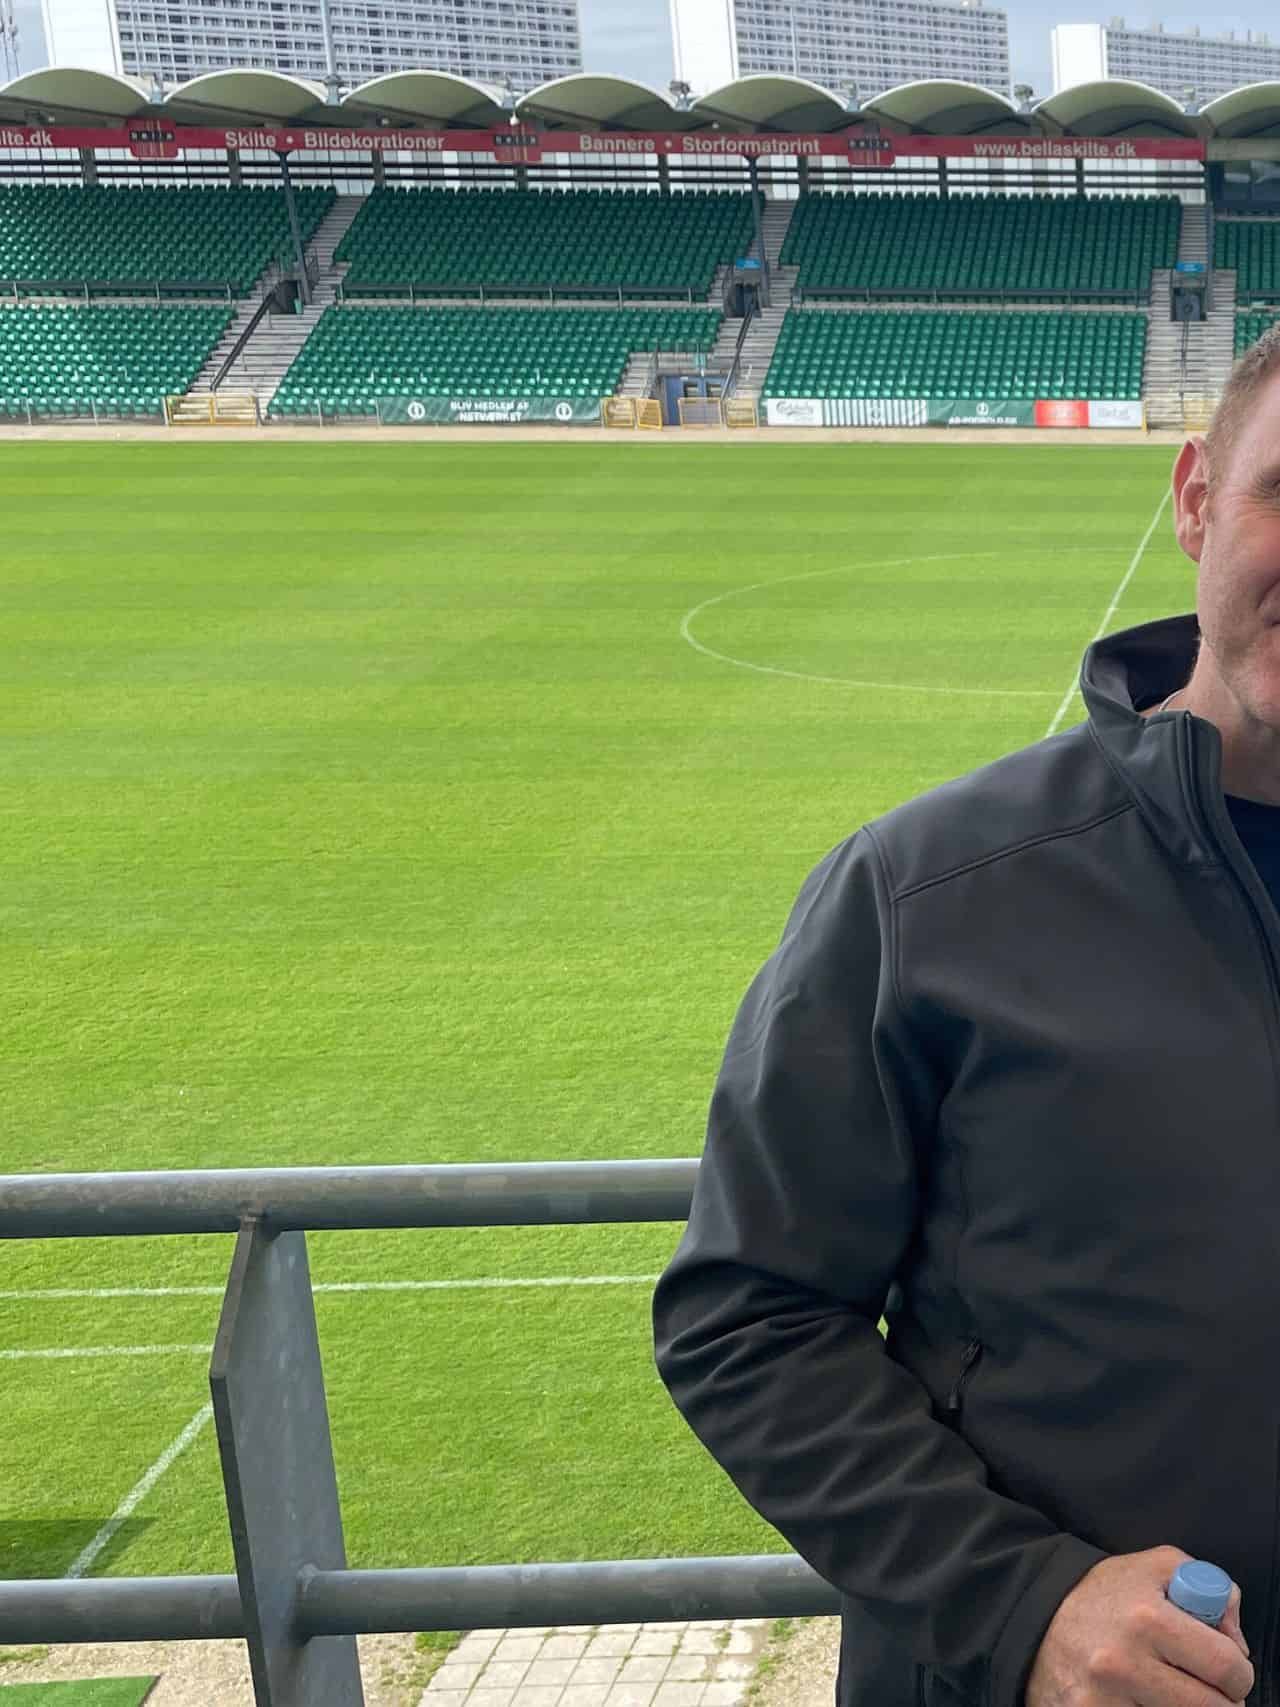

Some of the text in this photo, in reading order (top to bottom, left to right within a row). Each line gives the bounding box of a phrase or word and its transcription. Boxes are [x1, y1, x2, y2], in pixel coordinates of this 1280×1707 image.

[224, 131, 445, 149] Skilte Bildekorationer
[579, 135, 820, 154] Bannere Storformatprint
[974, 140, 1137, 157] www.bellaskilte.dk
